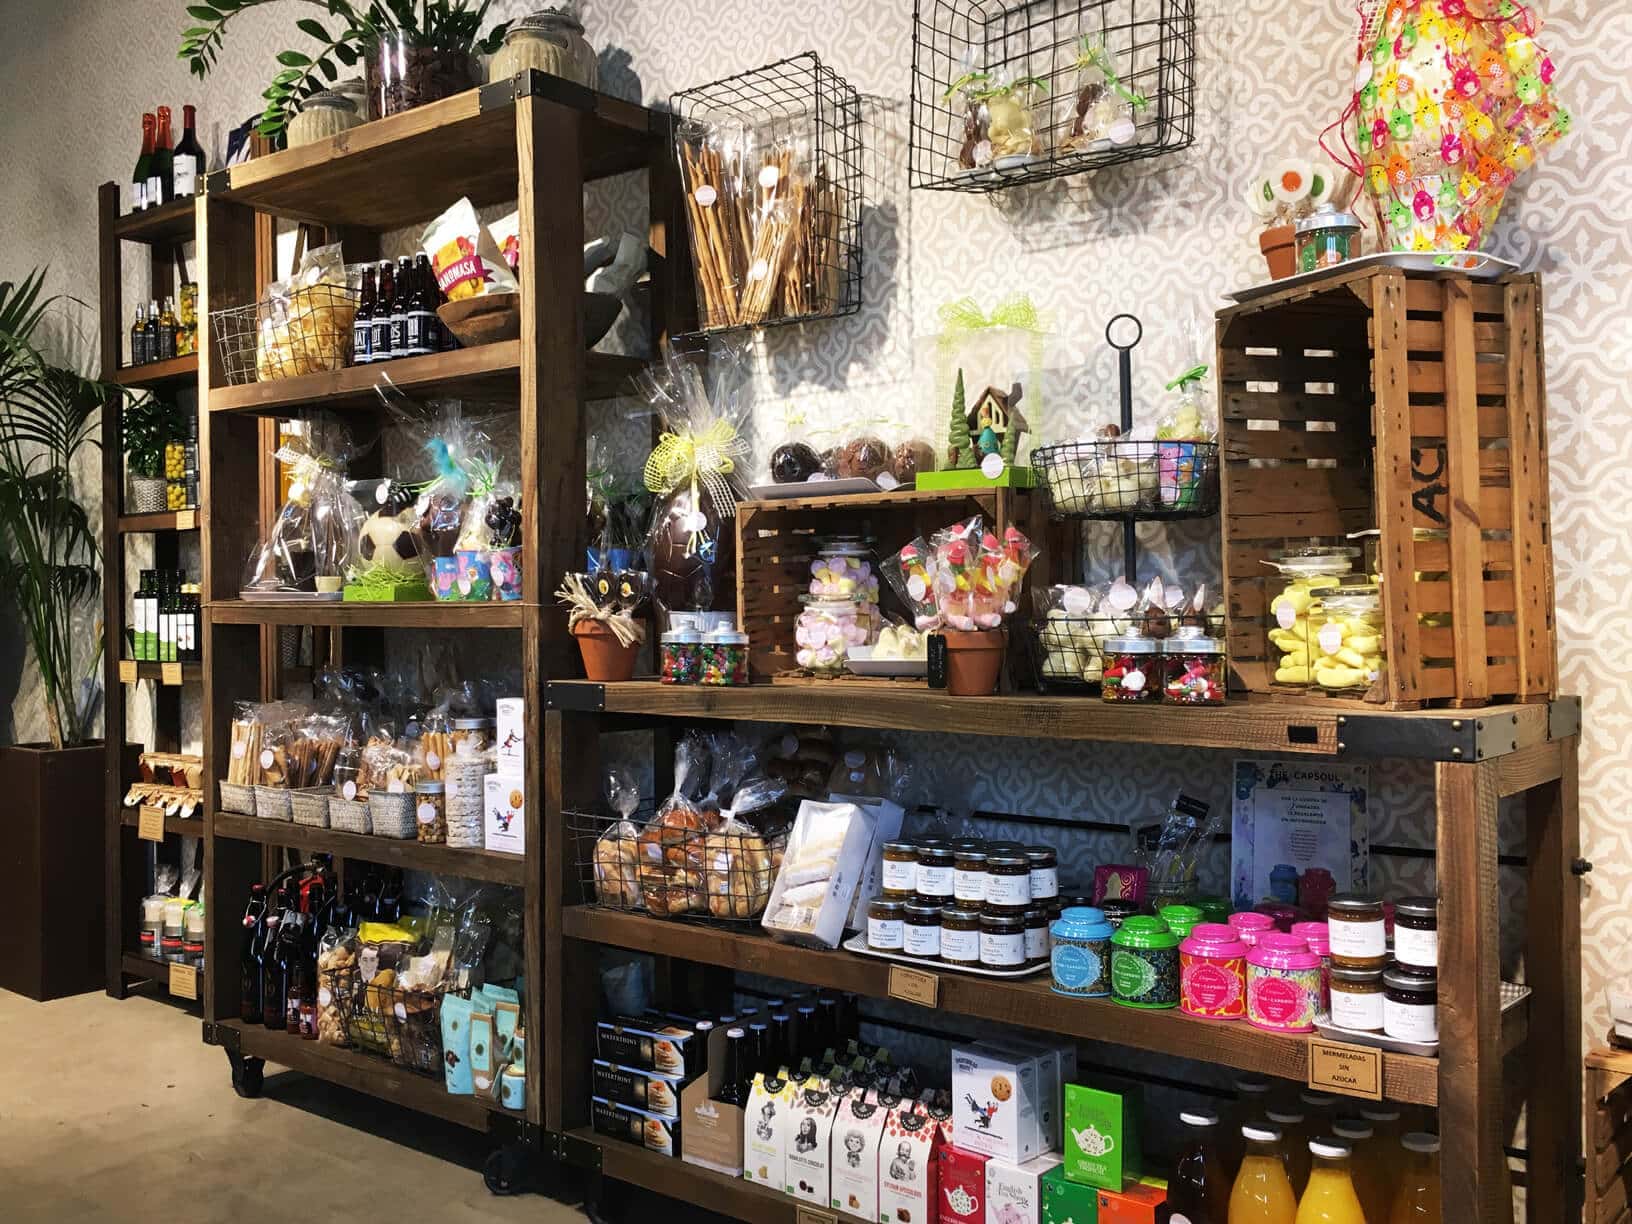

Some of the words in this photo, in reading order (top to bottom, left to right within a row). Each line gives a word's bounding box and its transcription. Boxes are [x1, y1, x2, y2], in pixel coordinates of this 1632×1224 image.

[1294, 771, 1342, 782] CAPSOUL
[1322, 1049, 1367, 1062] MERMELADAS
[1331, 1074, 1357, 1084] AZUCAR
